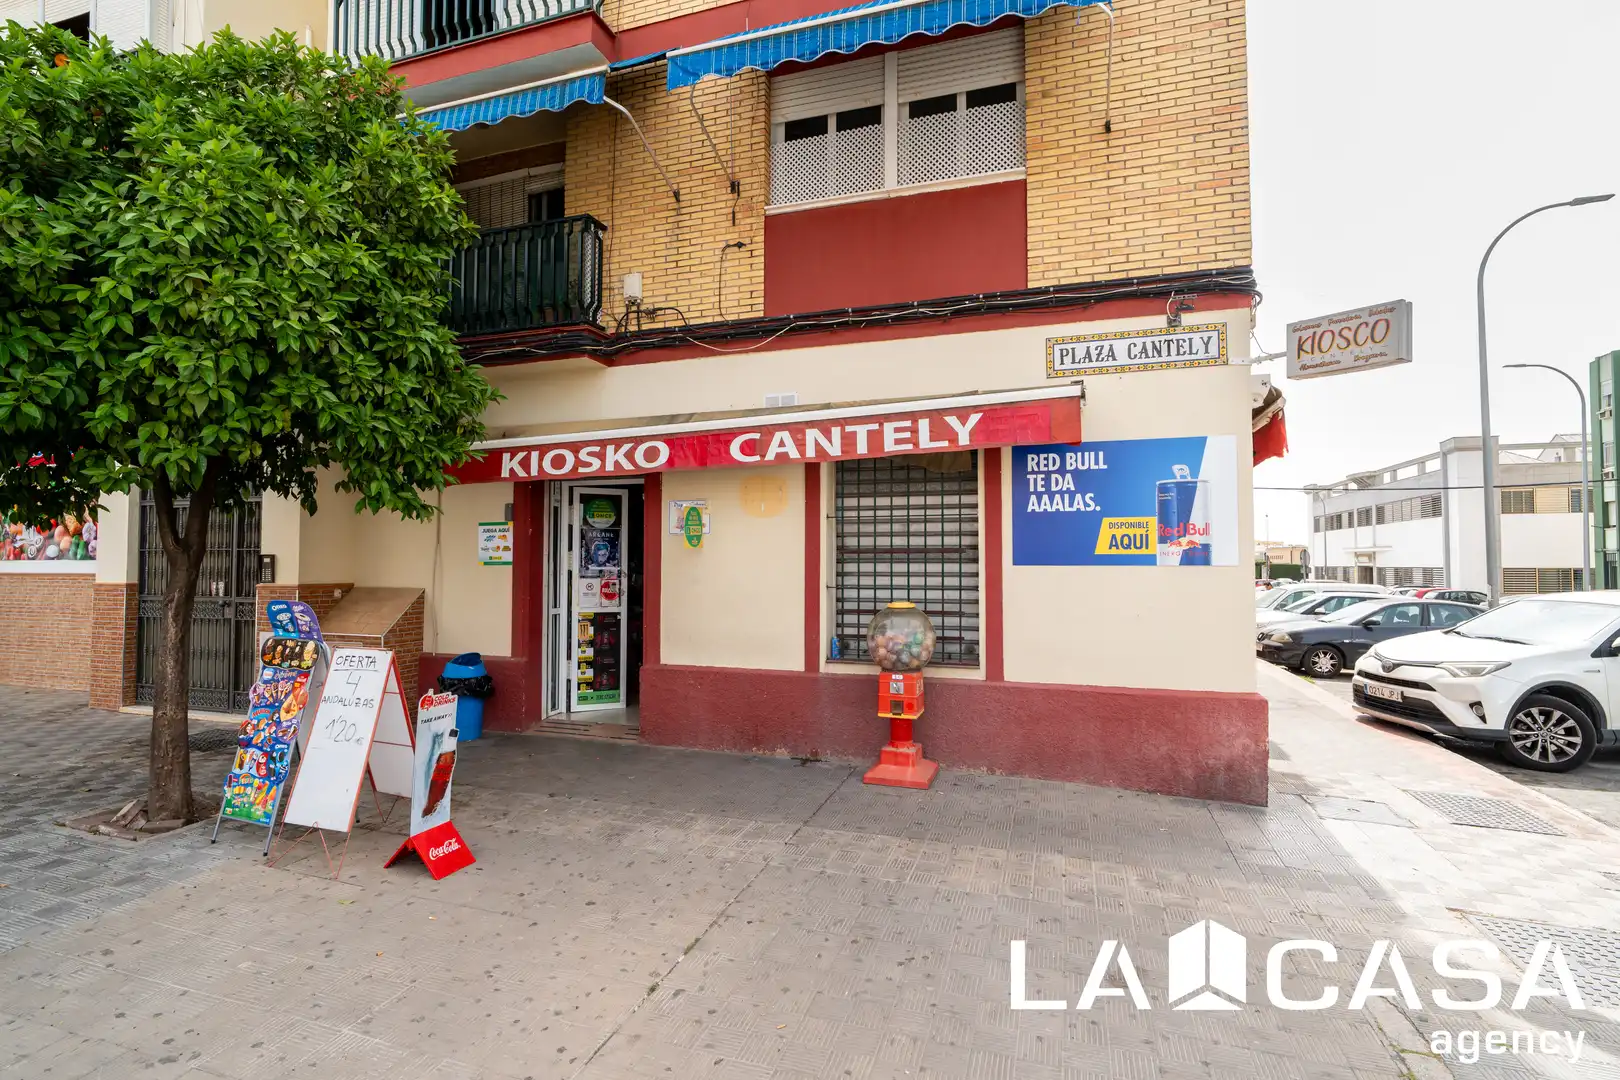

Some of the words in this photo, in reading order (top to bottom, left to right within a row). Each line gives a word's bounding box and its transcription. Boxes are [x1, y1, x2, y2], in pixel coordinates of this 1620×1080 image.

[1296, 318, 1391, 360] KIOSCO
[1058, 343, 1118, 366] PLAZA
[1127, 335, 1214, 360] CANTELY
[500, 440, 670, 478] KIOSKO
[729, 412, 984, 463] CANTELY
[1026, 453, 1061, 472] RED
[1066, 451, 1107, 470] BULL
[1026, 474, 1046, 492] TE
[1050, 473, 1076, 492] DA
[1026, 493, 1101, 513] AAALAS.
[1108, 521, 1150, 530] DISPONIBLE
[1157, 523, 1184, 537] Red
[1186, 522, 1211, 537] Bull
[1108, 530, 1150, 550] AQUÍ
[335, 655, 377, 669] OFERTA
[345, 671, 362, 696] 4
[1368, 685, 1385, 697] 0214
[320, 695, 375, 708] ANDALUZAS
[433, 698, 456, 707] DRINKS
[433, 713, 449, 721] AWAY
